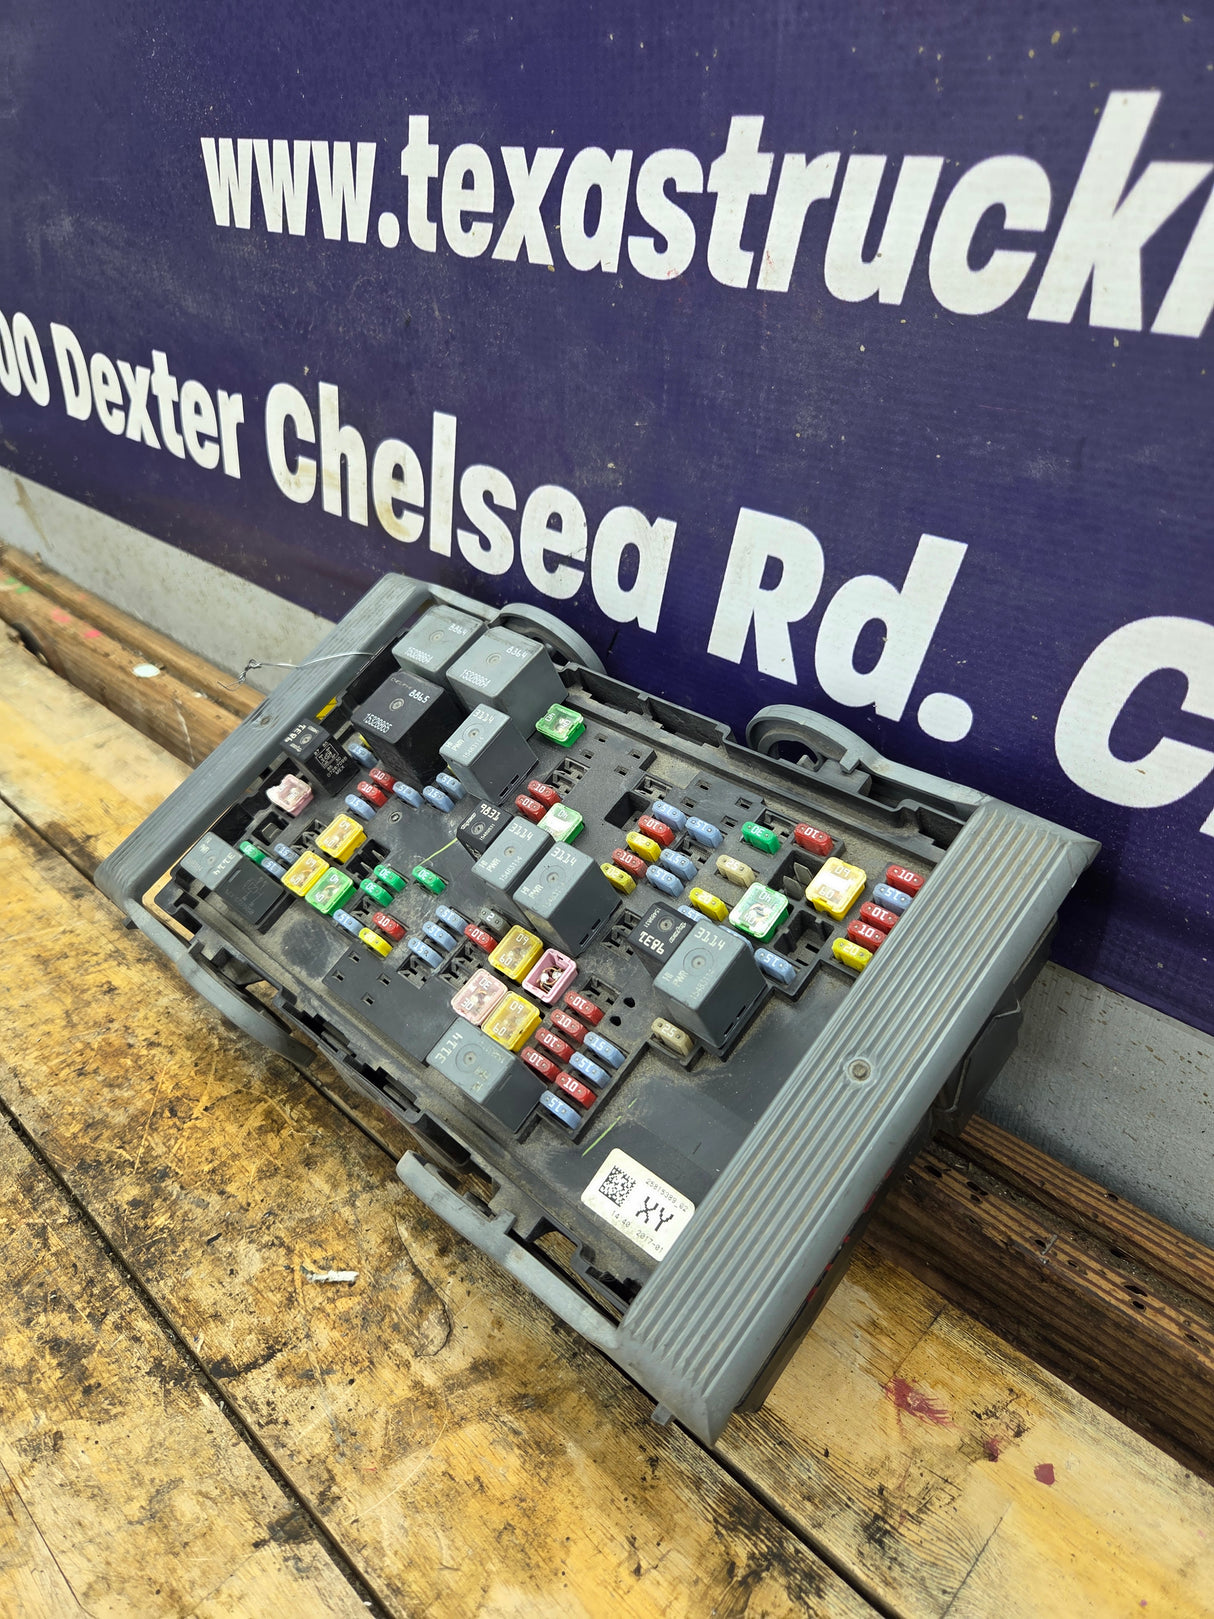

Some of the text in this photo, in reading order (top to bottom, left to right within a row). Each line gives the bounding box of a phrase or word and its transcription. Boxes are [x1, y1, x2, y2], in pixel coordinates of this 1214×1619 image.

[50, 322, 244, 479] Dexter
[265, 382, 677, 634] Chelsea
[708, 506, 973, 742] Rd.
[1054, 616, 1214, 839] C
[409, 689, 431, 704] 8865
[472, 708, 495, 724] 3114
[284, 724, 306, 742] 9831
[375, 771, 386, 780] 10
[442, 776, 451, 785] 15
[362, 783, 373, 792] 10
[399, 785, 409, 794] 15
[428, 788, 438, 798] 15
[535, 783, 546, 793] 10
[350, 797, 360, 807] 15
[523, 798, 534, 809] 10
[480, 803, 501, 821] 9831
[660, 803, 673, 815] 15
[646, 819, 659, 830] 10
[696, 819, 709, 831] 15
[750, 825, 765, 837] 30
[508, 822, 534, 841] 3114
[804, 827, 820, 839] 10
[551, 847, 577, 866] 3114
[620, 852, 633, 864] 10
[667, 853, 681, 864] 15
[725, 858, 739, 871] 25
[834, 865, 851, 877] 60
[379, 868, 391, 880] 30
[418, 869, 430, 881] 30
[605, 866, 620, 878] 20
[654, 869, 666, 881] 15
[897, 869, 914, 882] 10
[365, 882, 377, 893] 30
[884, 887, 901, 900] 15
[697, 892, 713, 905] 20
[758, 890, 772, 902] 40
[340, 913, 351, 924] 15
[443, 910, 454, 921] 15
[871, 907, 889, 920] 10
[378, 915, 390, 927] 10
[429, 926, 442, 937] 15
[470, 928, 484, 939] 10
[858, 924, 875, 938] 10
[515, 933, 530, 946] 60
[638, 931, 665, 955] 9831
[694, 926, 726, 951] 3114
[414, 941, 425, 953] 15
[842, 943, 860, 956] 20
[763, 954, 779, 968] 15
[478, 977, 493, 990] 30
[509, 1001, 524, 1014] 60
[572, 996, 587, 1010] 10
[557, 1014, 572, 1028] 10
[661, 1023, 675, 1038] 25
[543, 1033, 558, 1047] 10
[591, 1036, 605, 1050] 15
[434, 1033, 463, 1064] 3114
[529, 1052, 544, 1066] 10
[577, 1058, 592, 1072] 15
[563, 1077, 578, 1092] 10
[548, 1097, 564, 1112] 15
[635, 1196, 674, 1232] XY
